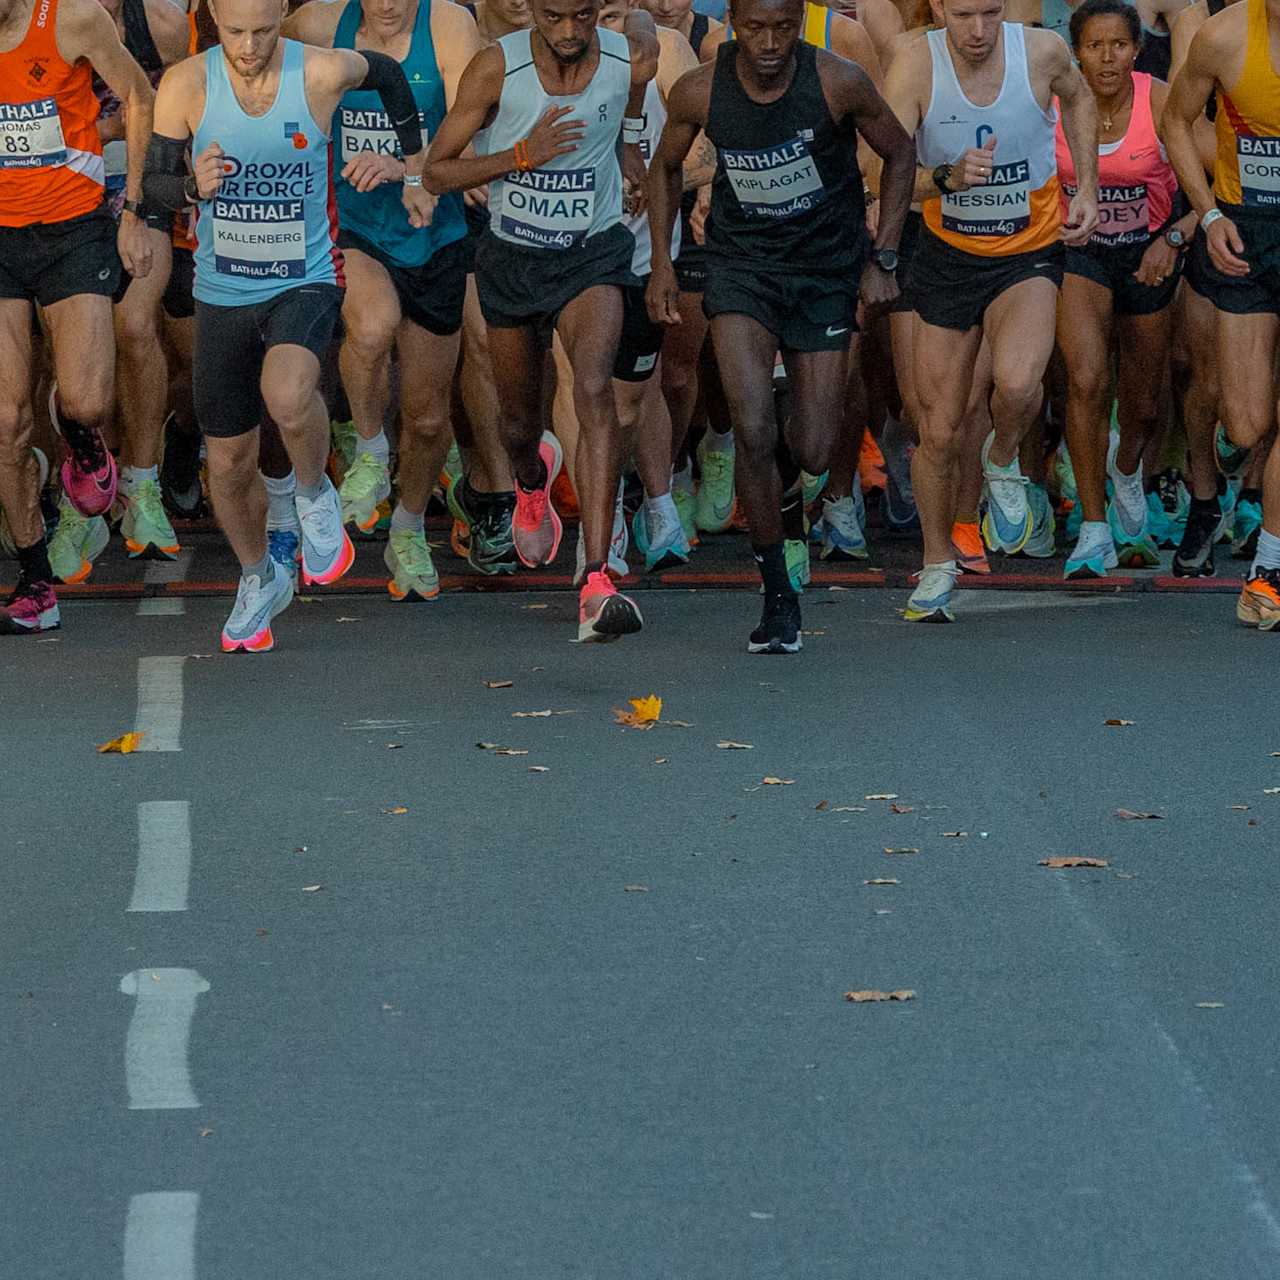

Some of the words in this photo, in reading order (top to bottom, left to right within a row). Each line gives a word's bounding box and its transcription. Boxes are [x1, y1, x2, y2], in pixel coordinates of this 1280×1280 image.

[4, 135, 31, 153] 83
[723, 142, 805, 170] BATHALF
[245, 161, 315, 179] ROYAL
[735, 166, 813, 191] KIPLAGAT
[218, 181, 240, 197] IR
[244, 178, 315, 198] FORCE
[507, 170, 594, 191] BATHALF
[508, 191, 590, 219] OMAR
[945, 190, 1027, 208] HESSIAN
[215, 201, 302, 220] BATHALF
[218, 230, 302, 244] KALLENBERG
